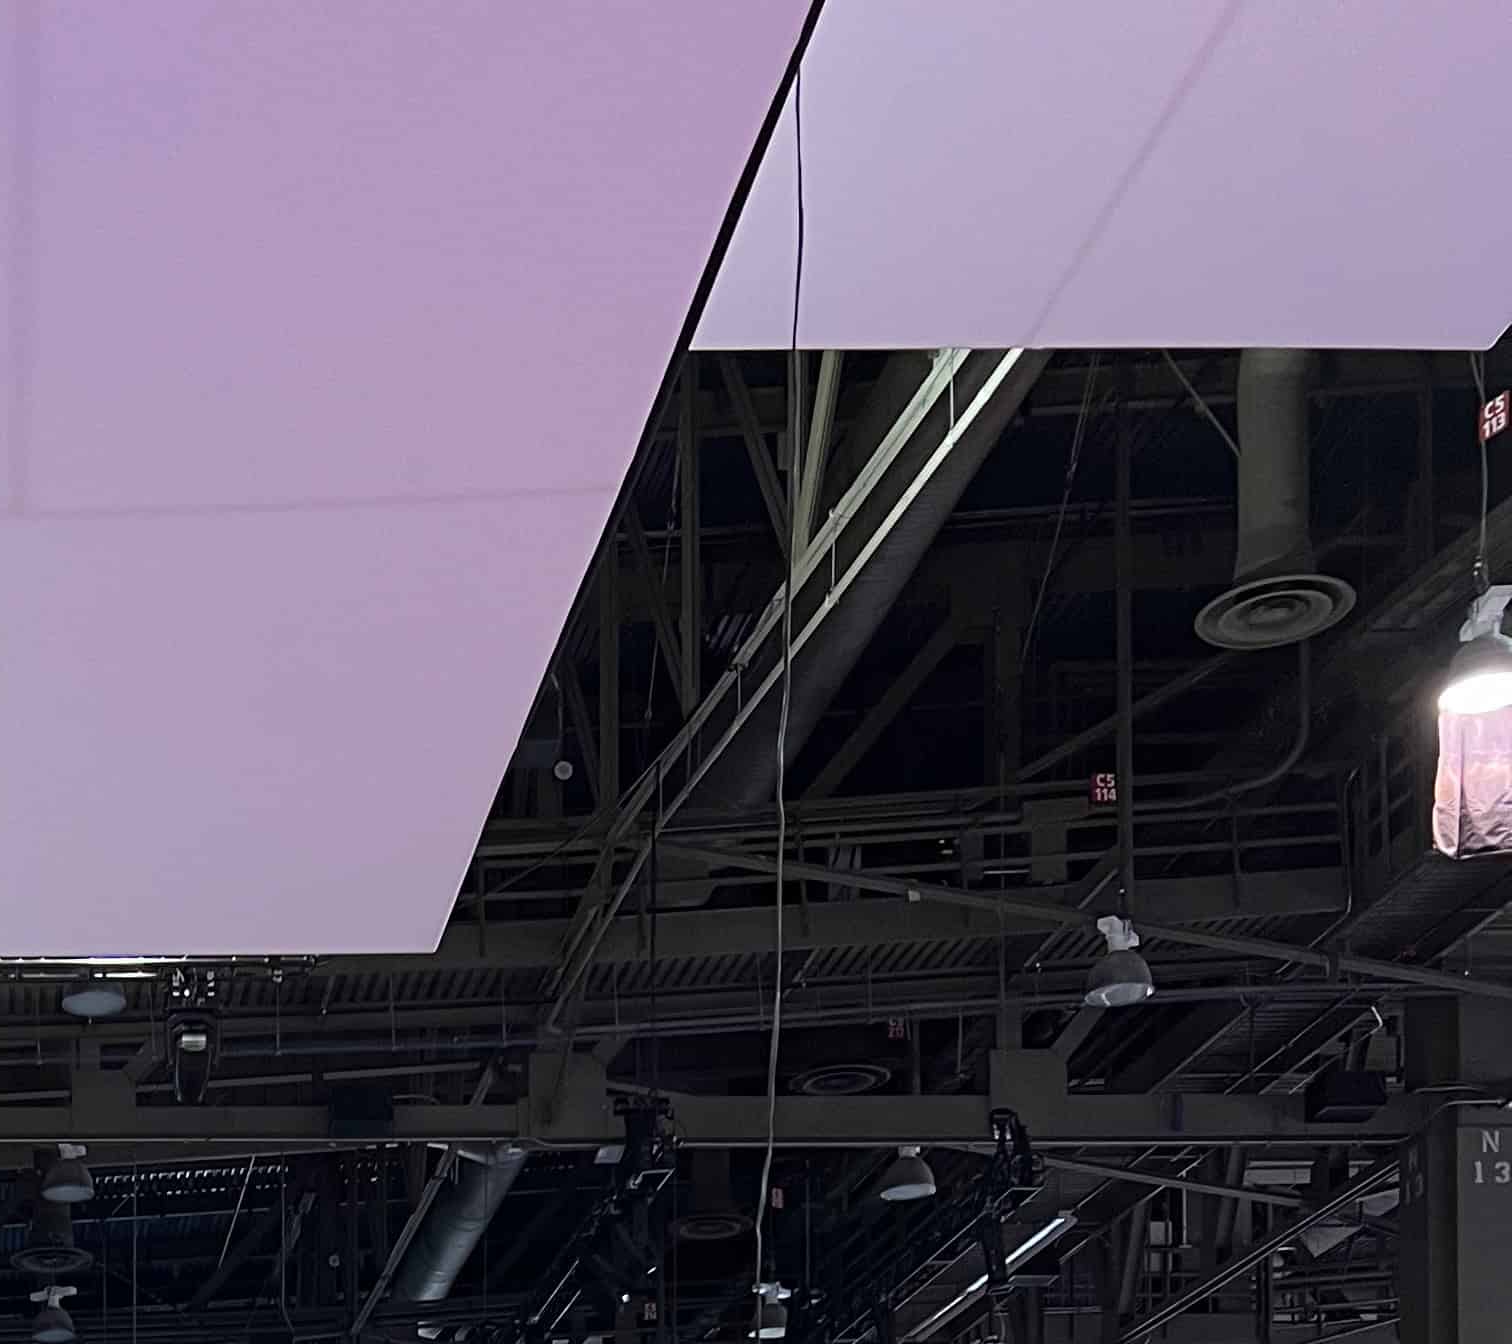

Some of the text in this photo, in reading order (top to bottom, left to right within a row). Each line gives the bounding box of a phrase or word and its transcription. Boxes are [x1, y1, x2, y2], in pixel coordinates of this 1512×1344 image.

[1484, 393, 1505, 418] C5
[1096, 773, 1115, 787] C5
[1095, 788, 1116, 801] 114
[1480, 1129, 1500, 1153] N
[1474, 1161, 1510, 1183] 13
